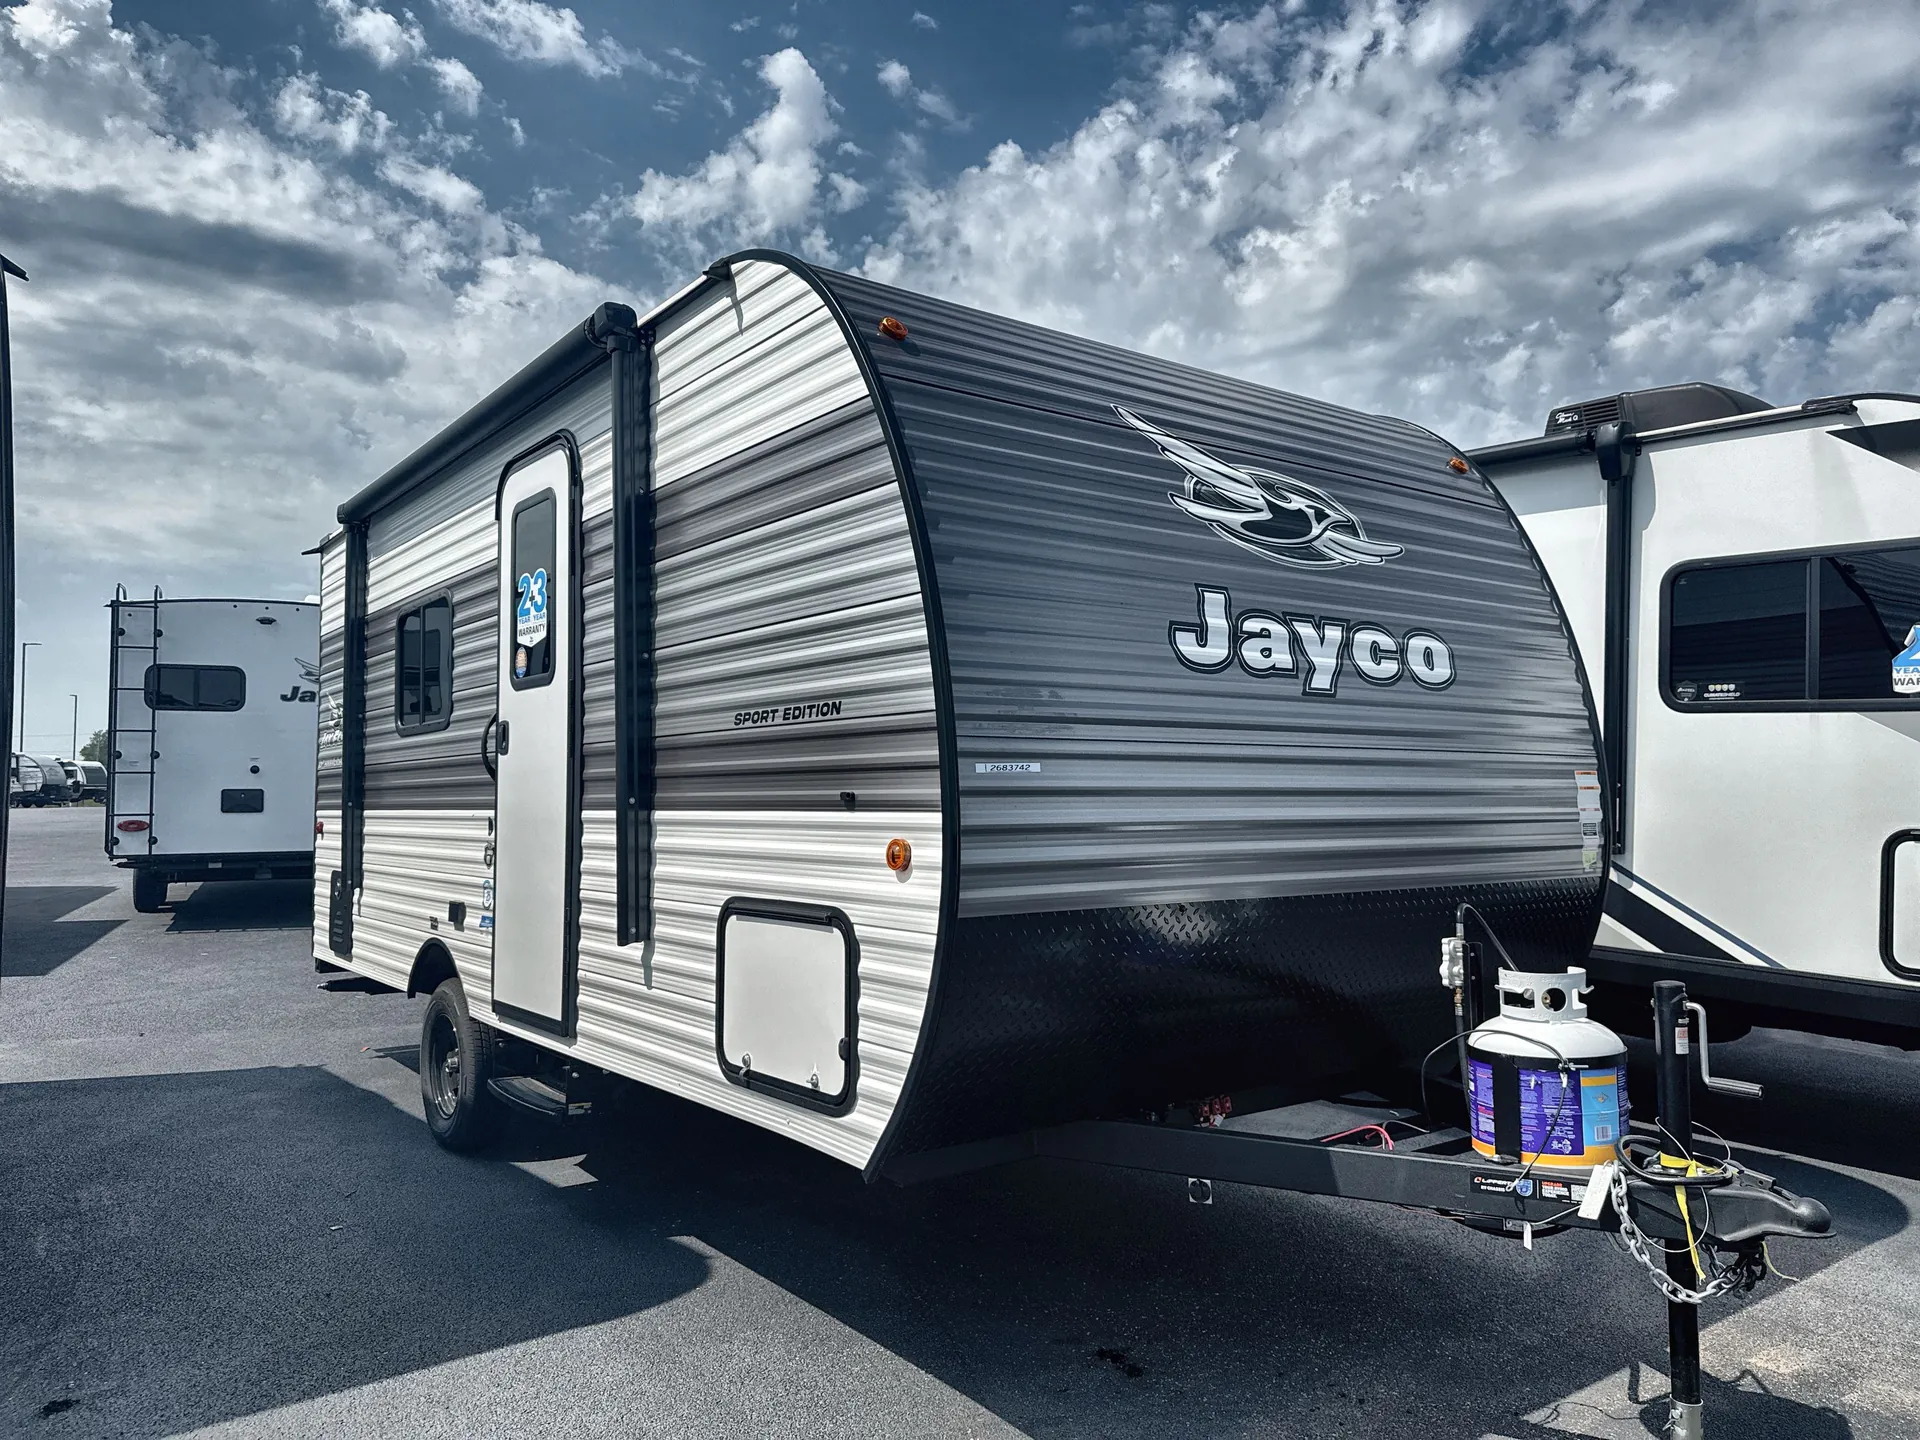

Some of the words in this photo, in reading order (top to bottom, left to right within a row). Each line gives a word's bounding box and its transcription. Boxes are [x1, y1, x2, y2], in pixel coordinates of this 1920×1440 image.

[519, 623, 545, 637] WARRANTY
[1168, 583, 1456, 698] Jayco
[279, 686, 318, 703] Ja
[734, 709, 779, 726] SPORT
[783, 701, 842, 721] EDITION
[990, 764, 1031, 772] 2683742
